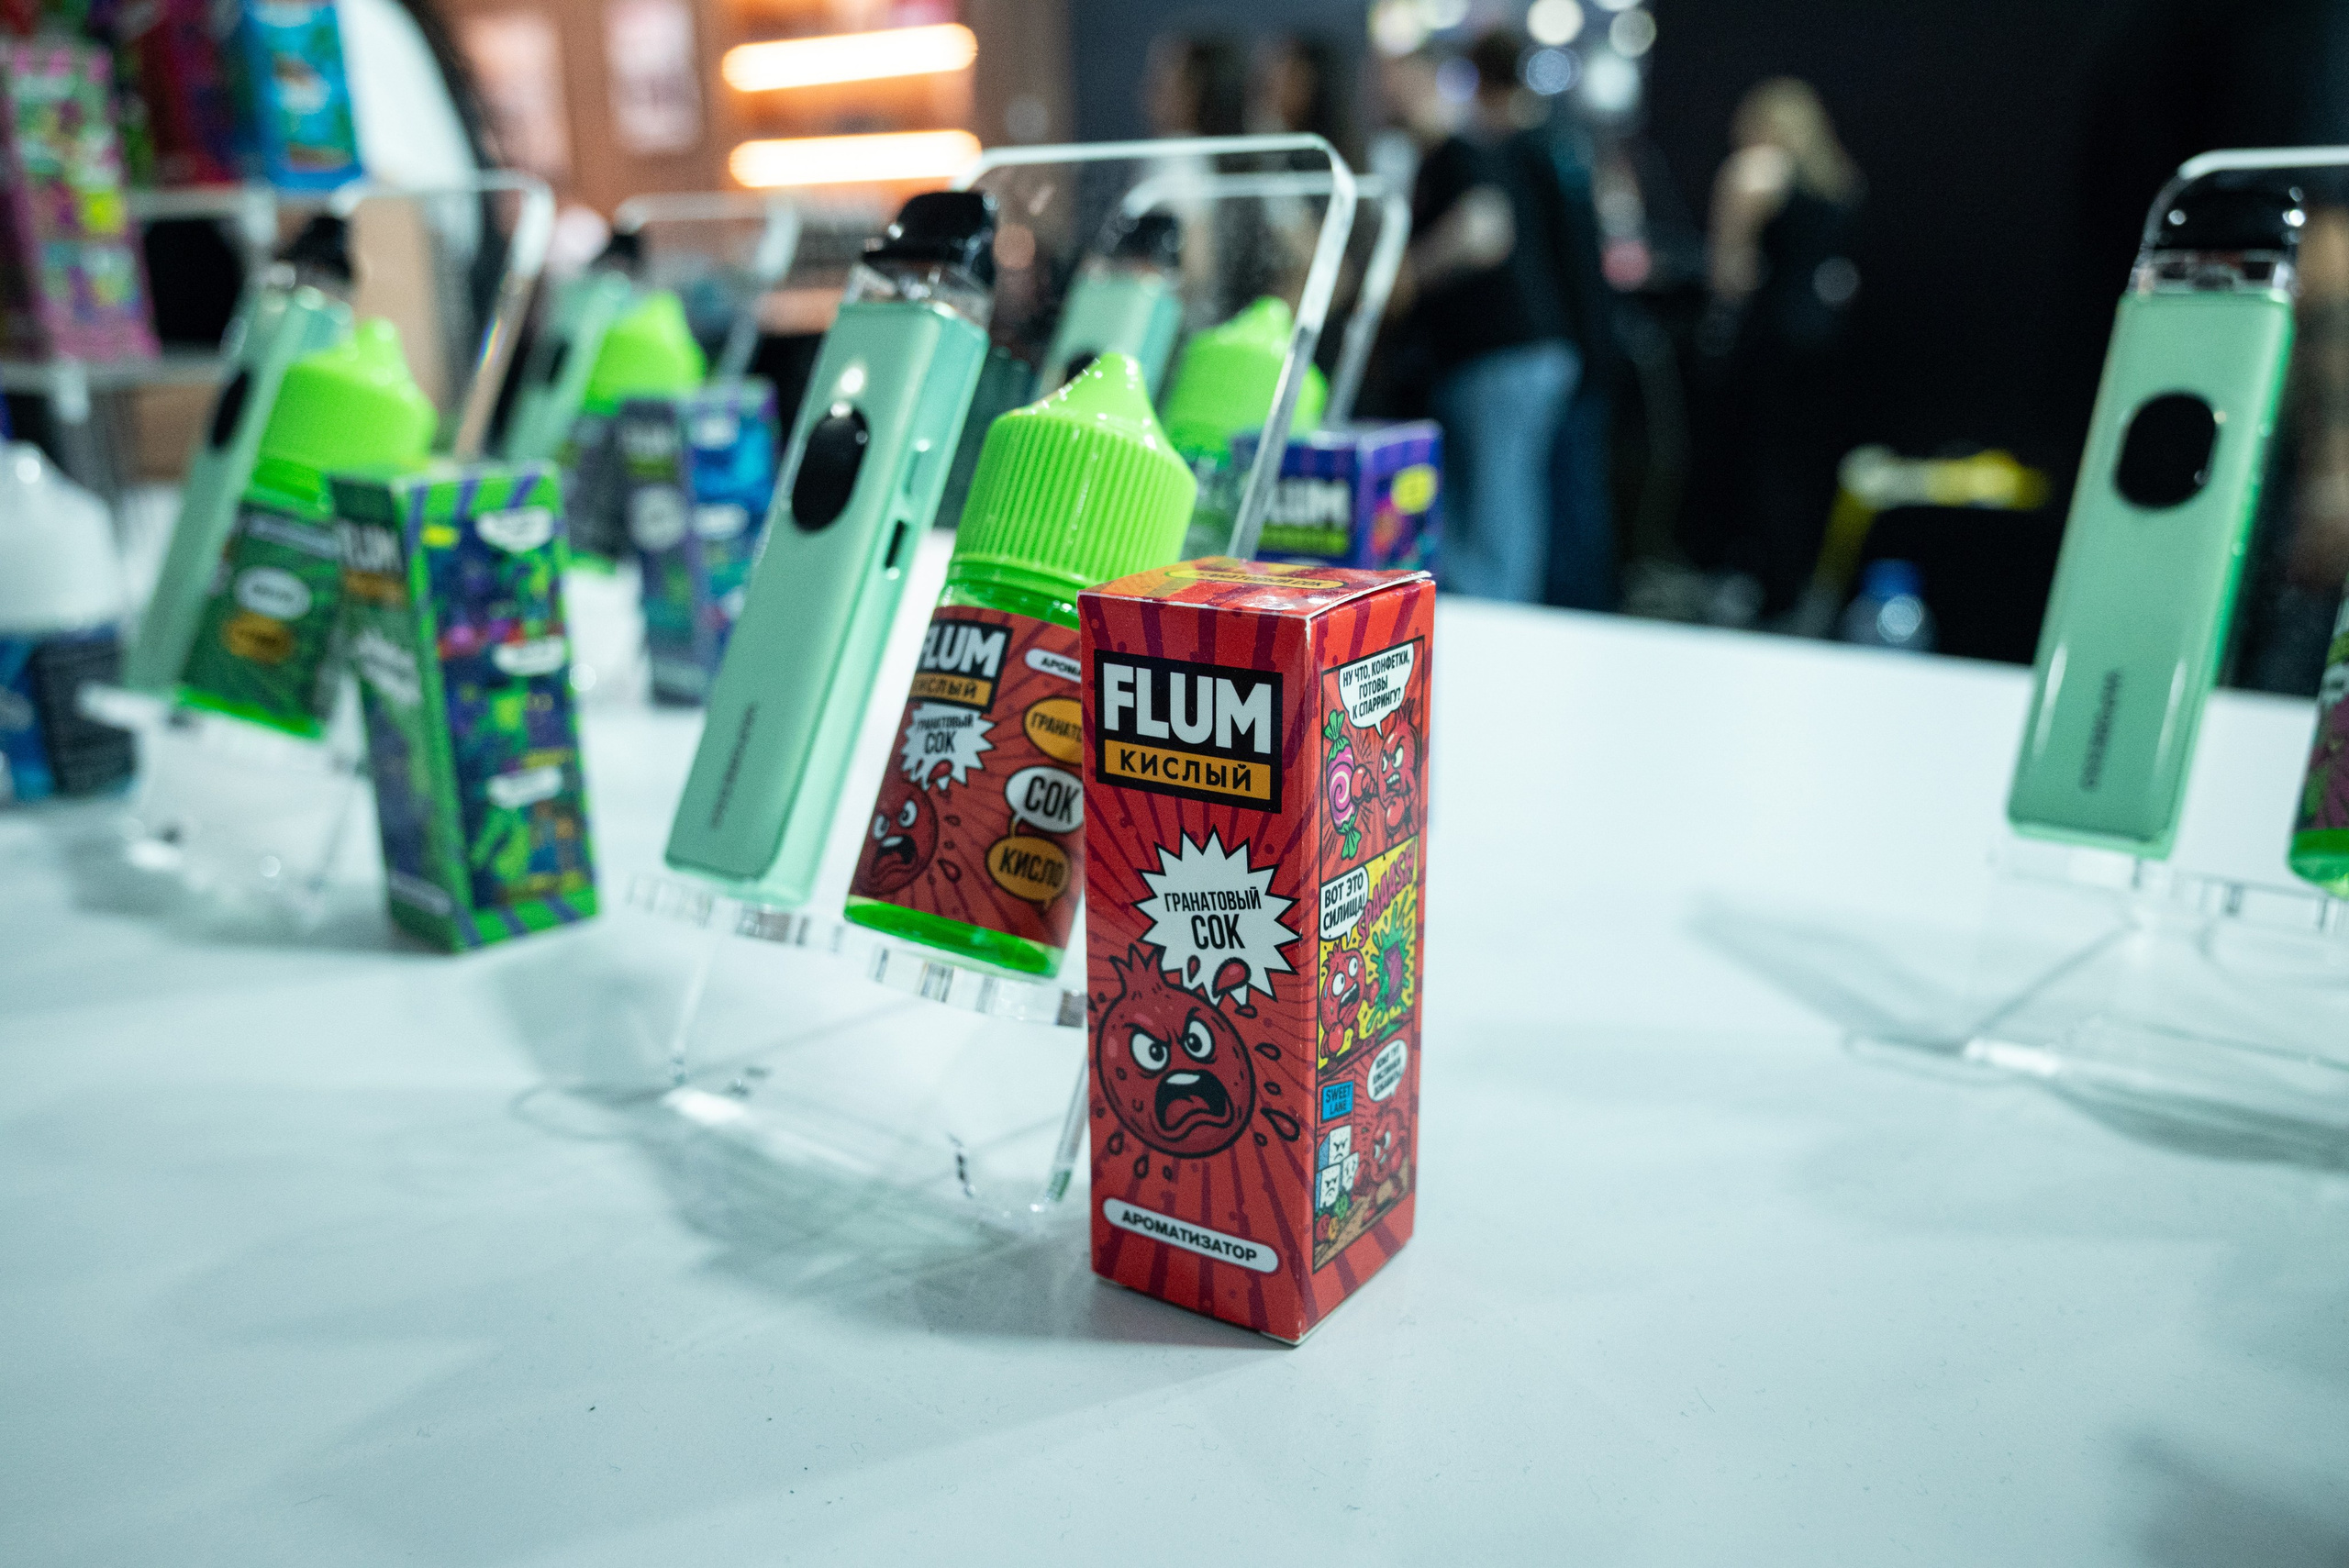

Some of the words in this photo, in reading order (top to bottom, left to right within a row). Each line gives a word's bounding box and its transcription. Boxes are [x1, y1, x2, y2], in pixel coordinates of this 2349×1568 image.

[1342, 671, 1353, 687] НУ
[1354, 664, 1371, 682] ЧТО,
[1371, 650, 1410, 675] КОНФЕТКИ,
[1353, 705, 1358, 720] К
[1359, 686, 1401, 717] СПАРРИНГУ?
[1359, 675, 1388, 700] ГОТОВЫ
[1103, 662, 1272, 754] FLUM
[925, 730, 957, 753] СОК
[1120, 749, 1251, 792] КИСЛЫЙ
[1025, 774, 1080, 824] СОК
[1163, 886, 1262, 912] ГРАНАТОВЫЙ
[1324, 882, 1344, 909] ВОТ
[1346, 872, 1364, 897] ЭТО
[1323, 893, 1366, 931] СИЛИЩА!
[1191, 914, 1246, 950] СОК
[1326, 1084, 1352, 1103] SWEET
[1330, 1099, 1347, 1116] LANE
[1121, 1210, 1257, 1262] АРОМАТИЗАТОР
